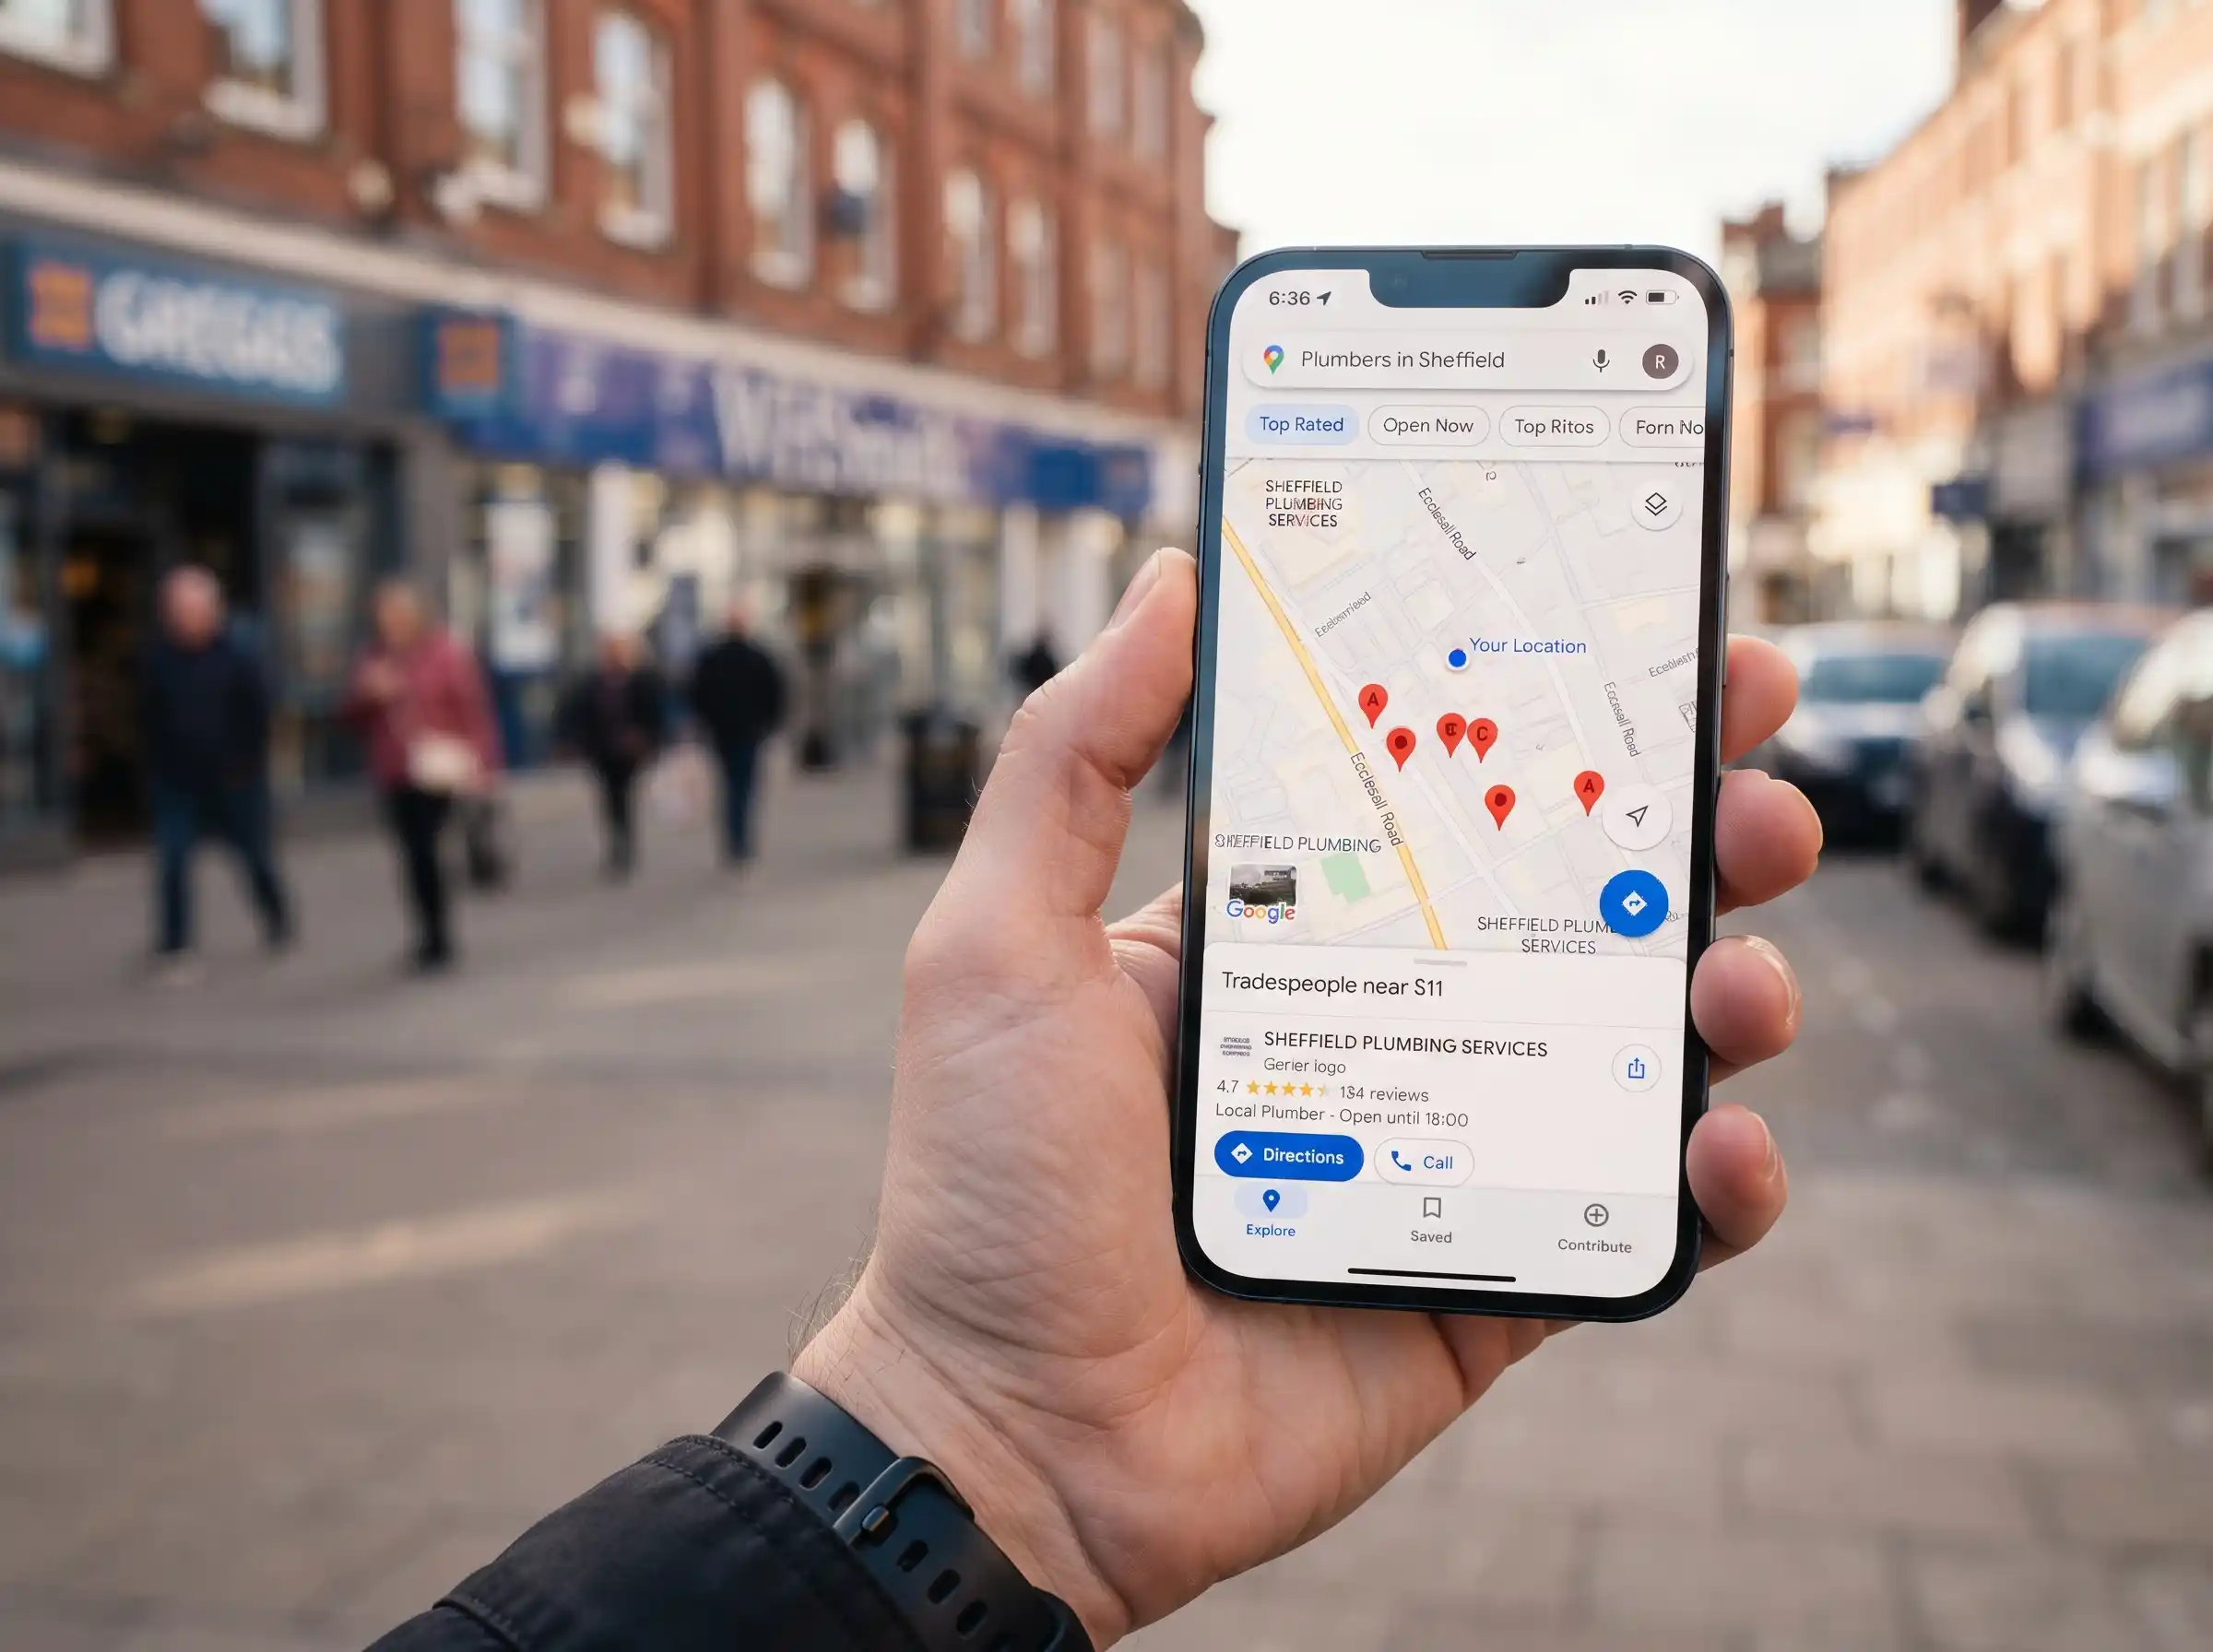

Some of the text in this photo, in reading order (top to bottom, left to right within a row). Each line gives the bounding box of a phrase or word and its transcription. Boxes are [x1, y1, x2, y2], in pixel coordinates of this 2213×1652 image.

[1269, 290, 1311, 306] 6:36
[1301, 350, 1505, 369] Plumbers in Sheffield
[1655, 354, 1666, 370] R
[1259, 416, 1344, 436] Top Rated
[1382, 417, 1474, 436] Open Now
[1514, 419, 1594, 438] Top Ritos
[1636, 419, 1703, 435] Forn No
[1265, 479, 1343, 493] SHEFFIELD
[1266, 498, 1343, 511] PLUMBING
[1269, 513, 1338, 527] SERVICES
[1418, 487, 1477, 560] Ecclesall Road
[1469, 637, 1587, 654] Your Location
[1367, 691, 1379, 706] A
[1476, 726, 1488, 742] C
[1622, 726, 1642, 758] Road
[1583, 778, 1595, 794] A
[1380, 811, 1403, 846] Road
[1297, 836, 1382, 854] PLUMBING
[1226, 900, 1296, 924] Google
[1477, 915, 1617, 934] SHEFFIELD PLUM
[1521, 938, 1596, 955] SERVICES
[1221, 971, 1442, 997] Tradespeople near S11
[1264, 1031, 1357, 1050] SHEFFIELD
[1363, 1035, 1458, 1054] PLUMBING
[1462, 1039, 1548, 1057] SERVICES
[1216, 1080, 1239, 1093] 4.7
[1369, 1086, 1429, 1103] reviews
[1215, 1103, 1257, 1118] Local
[1261, 1104, 1326, 1121] Plumber
[1339, 1108, 1382, 1127] Open
[1387, 1110, 1420, 1125] until
[1425, 1112, 1469, 1127] 18:00
[1263, 1147, 1344, 1165] Directions
[1423, 1155, 1453, 1170] Call
[1246, 1223, 1296, 1239] Explore
[1410, 1230, 1452, 1244] Saved
[1557, 1238, 1633, 1254] Contribute
